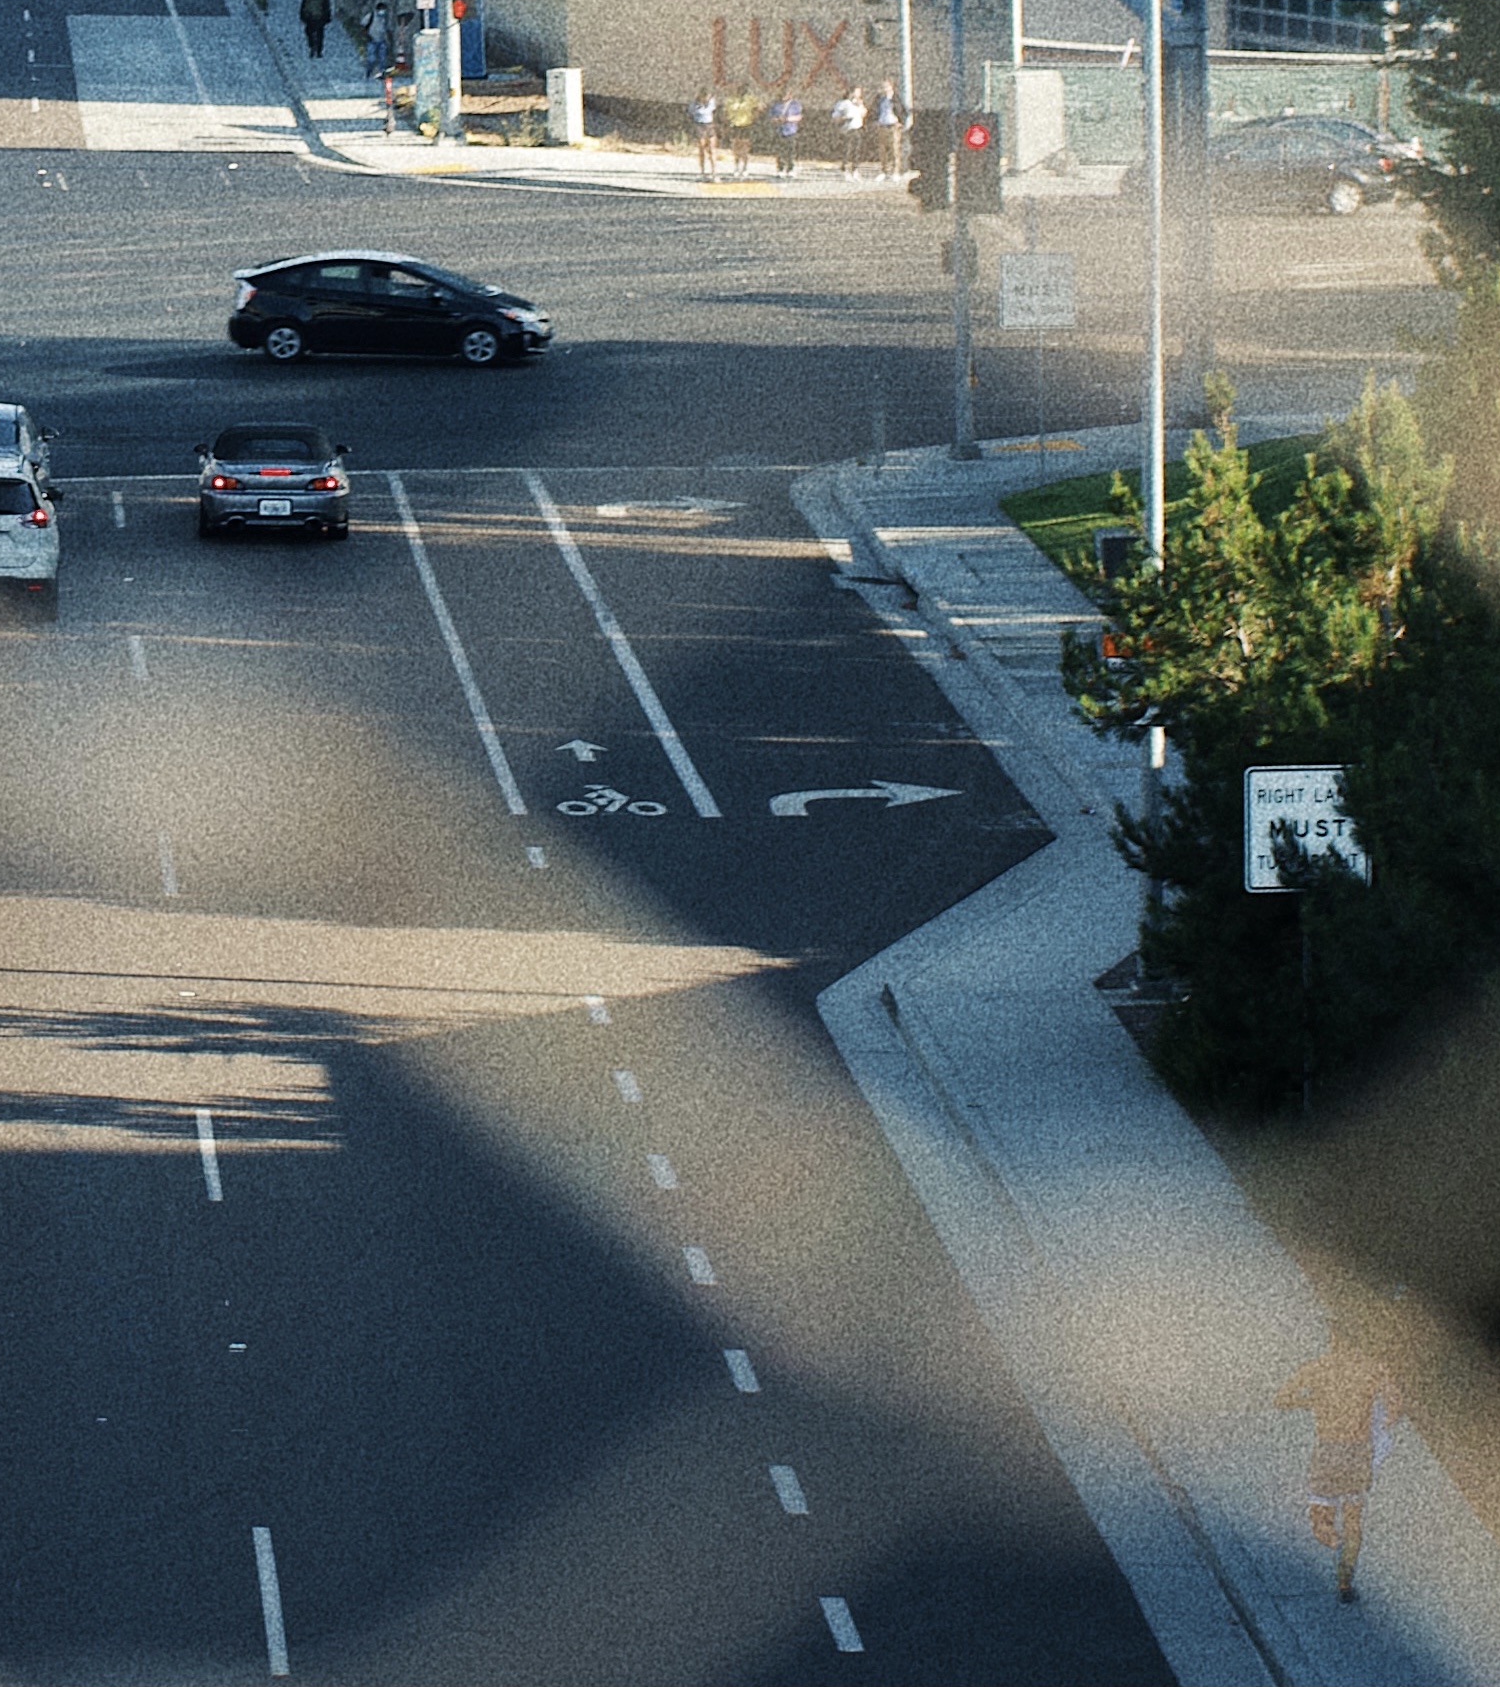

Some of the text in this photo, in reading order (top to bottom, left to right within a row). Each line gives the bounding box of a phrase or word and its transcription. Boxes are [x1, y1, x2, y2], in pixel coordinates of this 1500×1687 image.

[712, 17, 848, 90] LUX
[1257, 786, 1343, 804] RIGHT LA
[1270, 818, 1346, 837] MUST
